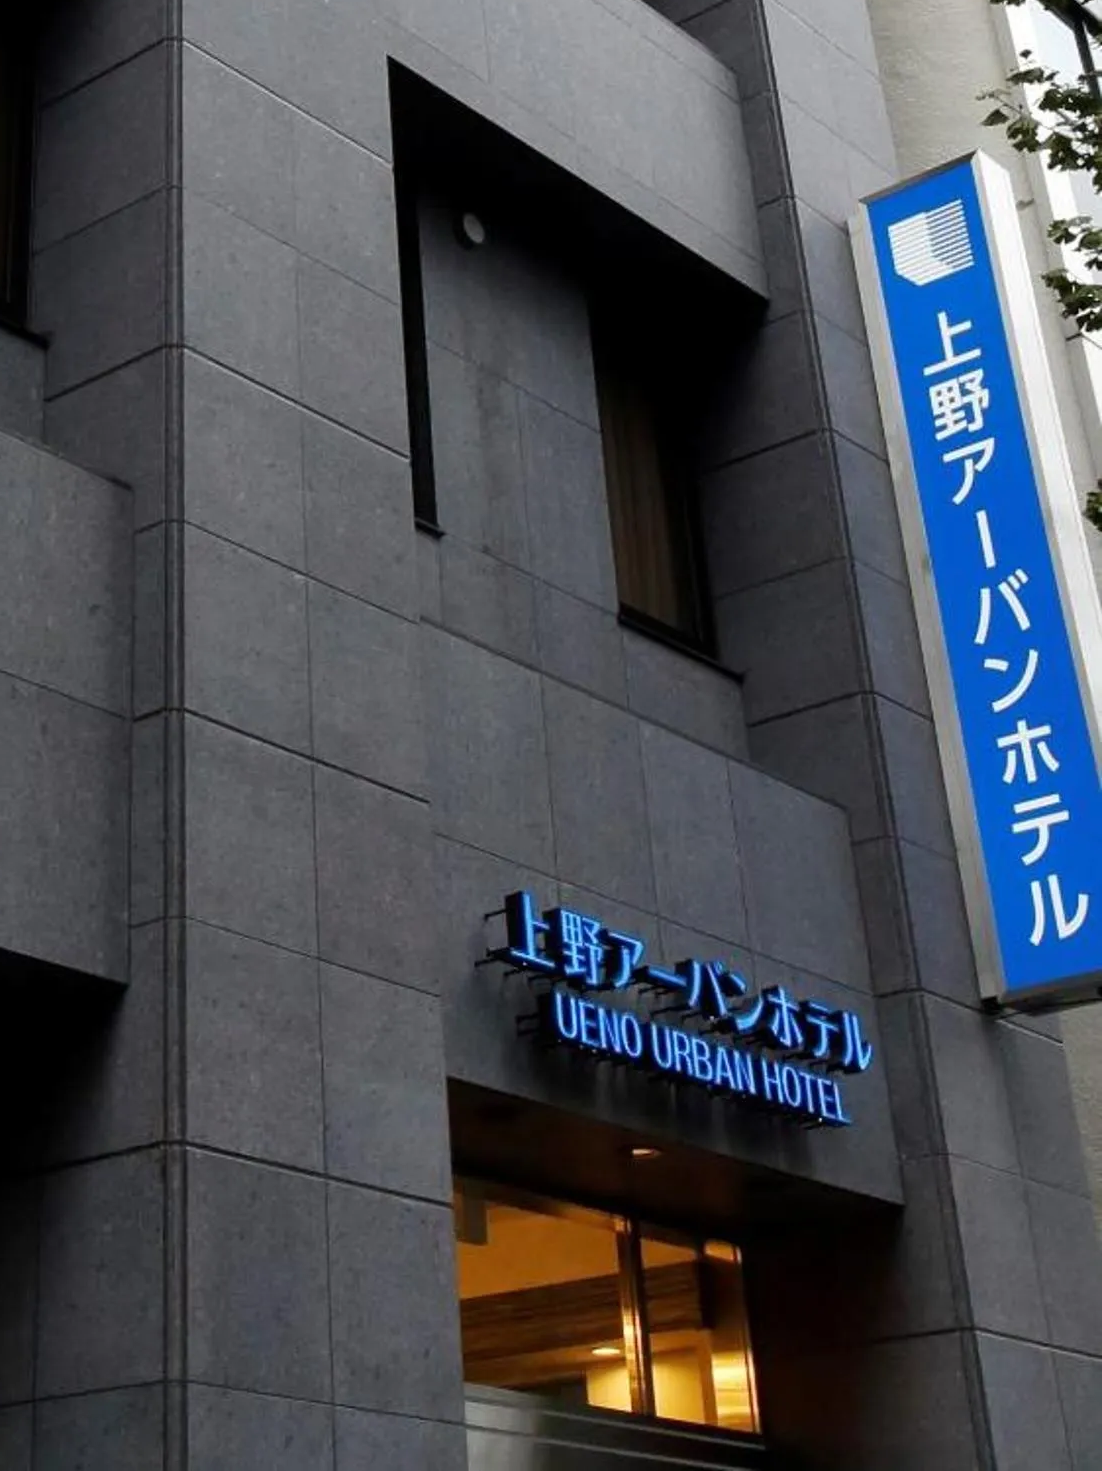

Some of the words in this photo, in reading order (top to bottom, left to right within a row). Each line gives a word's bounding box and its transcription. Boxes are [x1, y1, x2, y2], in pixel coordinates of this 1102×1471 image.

[923, 311, 1089, 946] 上野アーバンホテル
[508, 890, 873, 1071] 上野アーバンホテル
[554, 989, 643, 1059] UENO
[650, 1023, 757, 1095] URBAN
[762, 1059, 850, 1125] HOTEL
